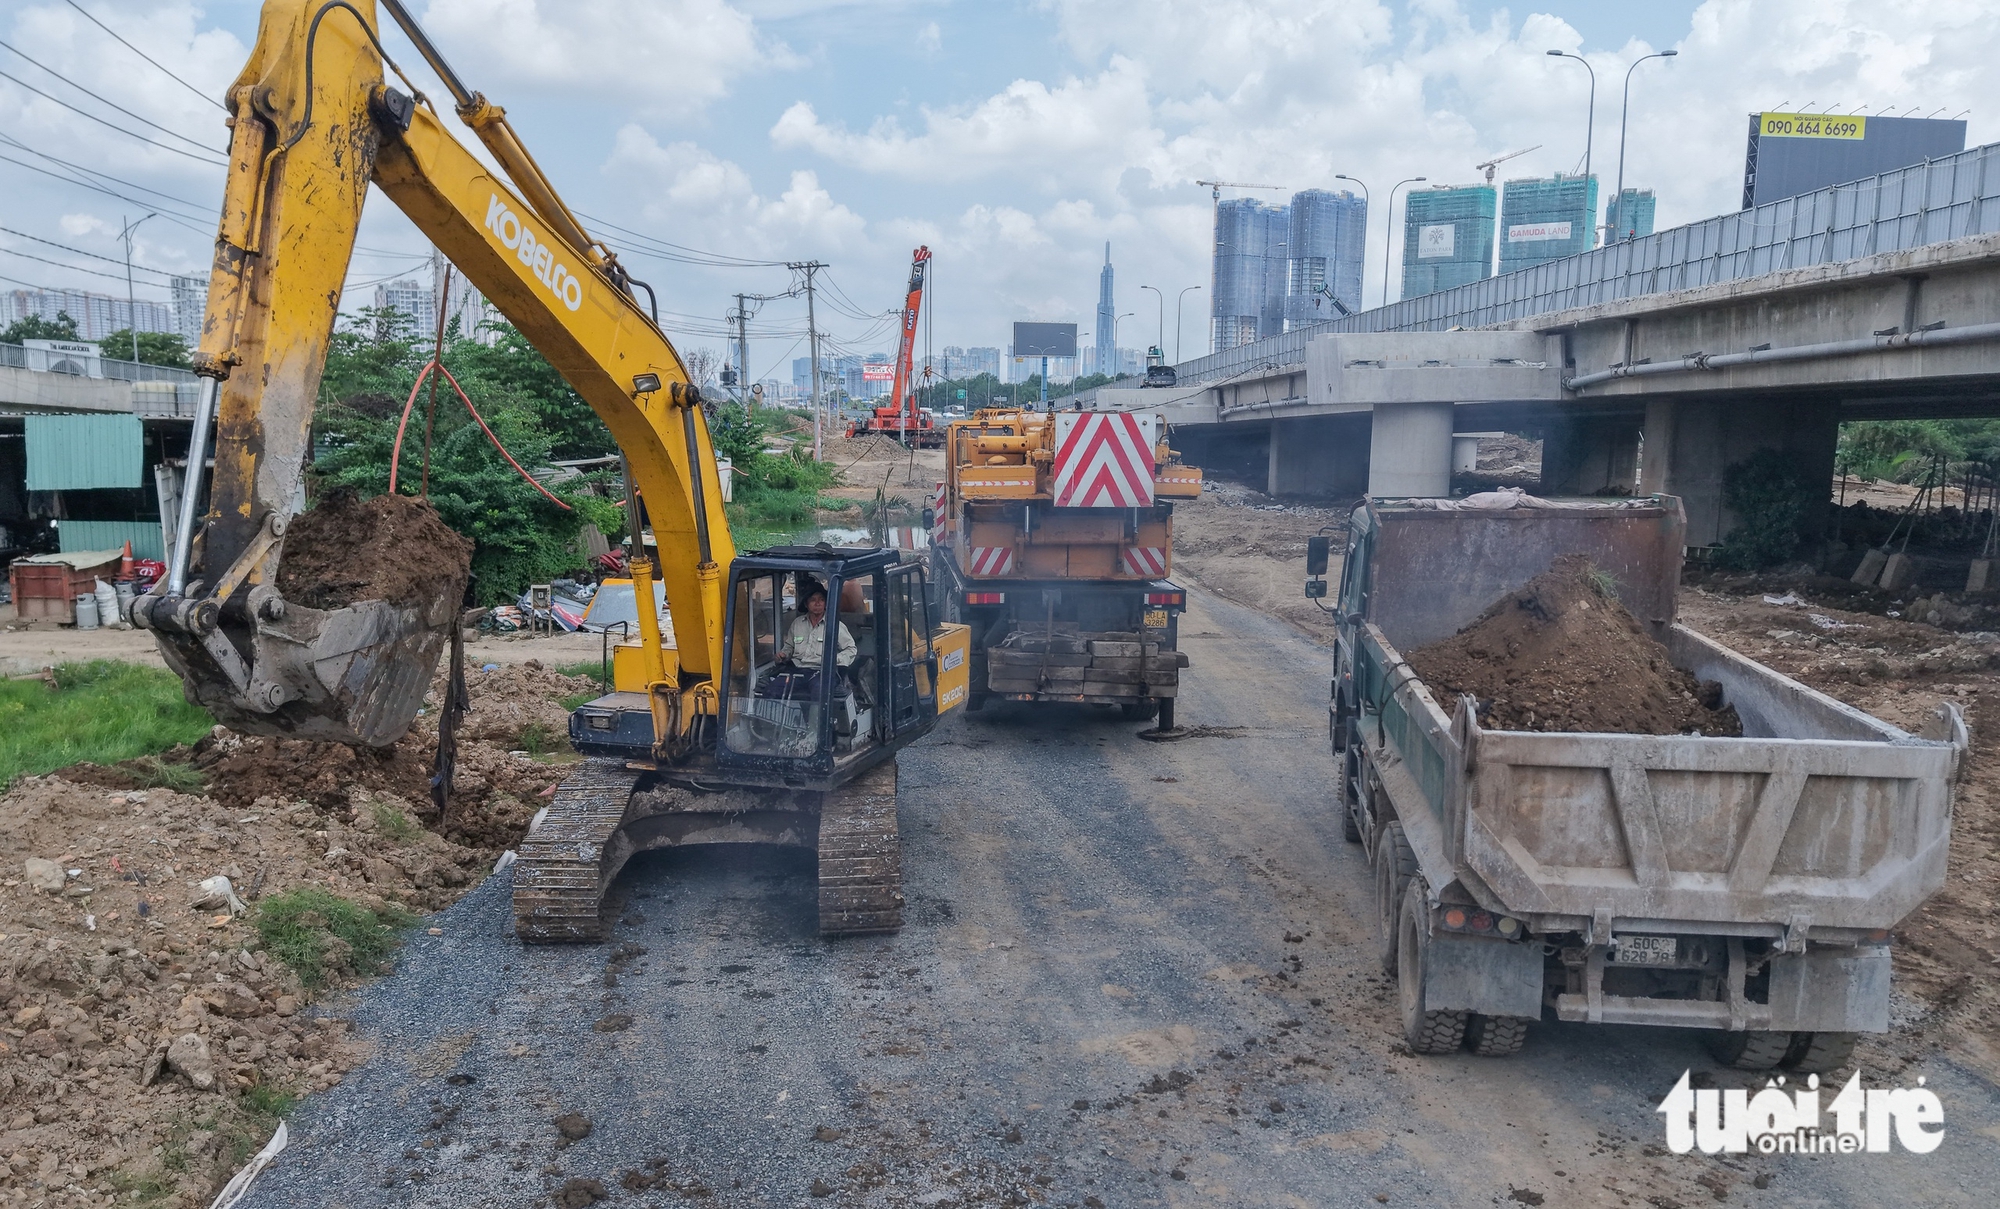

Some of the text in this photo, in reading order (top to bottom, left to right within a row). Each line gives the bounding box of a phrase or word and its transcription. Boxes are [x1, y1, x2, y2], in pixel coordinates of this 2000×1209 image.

[1767, 120, 1857, 137] 090 464 6699
[1510, 226, 1570, 238] GAMUDA LAND
[485, 192, 582, 312] KOBELCO
[907, 308, 915, 331] KATO
[1633, 937, 1660, 951] 60C
